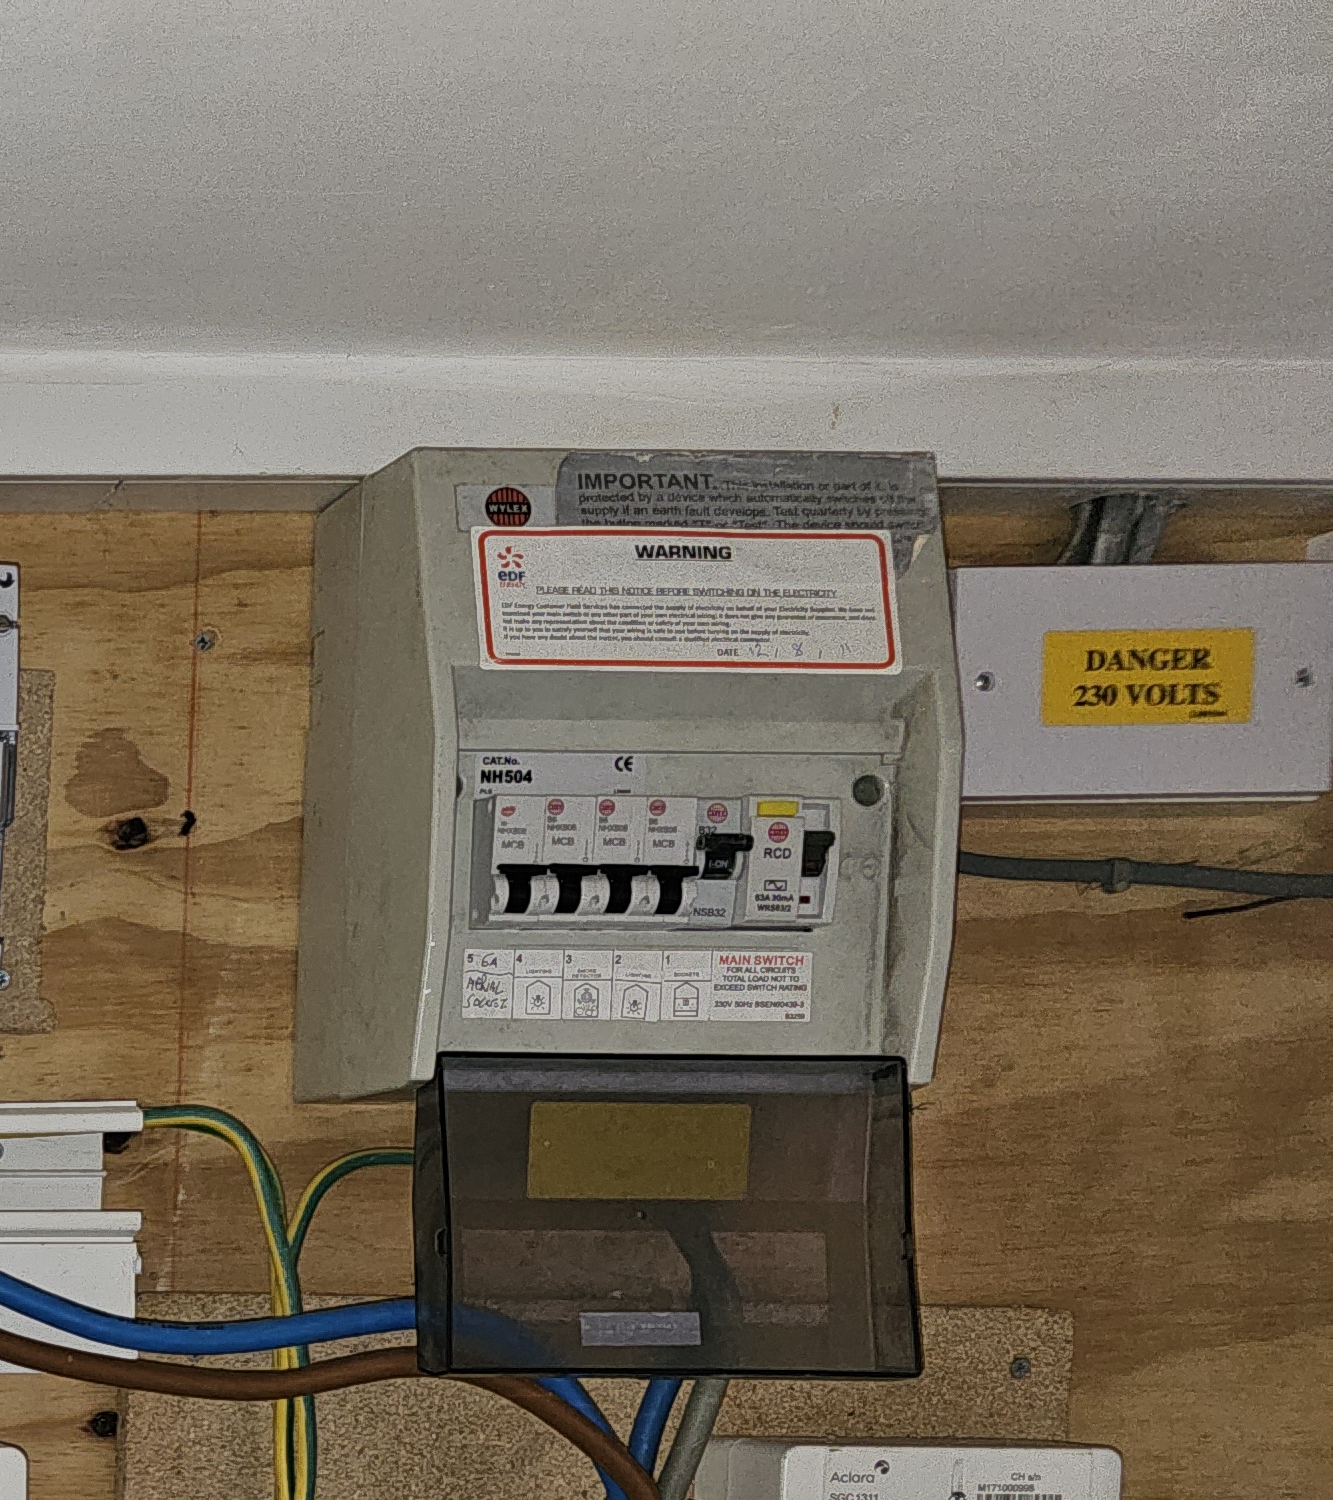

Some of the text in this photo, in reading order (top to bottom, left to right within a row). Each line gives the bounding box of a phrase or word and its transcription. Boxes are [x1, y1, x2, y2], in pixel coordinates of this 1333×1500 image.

[577, 472, 718, 490] IMPORTANT.
[486, 503, 529, 514] WYLEX
[635, 544, 732, 560] WARNING
[1086, 649, 1214, 672] DANGER
[1073, 683, 1222, 707] 230 VOLTS
[480, 769, 533, 784] NH504
[763, 848, 792, 859] RCD
[693, 907, 726, 918] NSB32
[718, 954, 805, 965] MAIN SWITCH
[830, 1471, 876, 1485] Aclara
